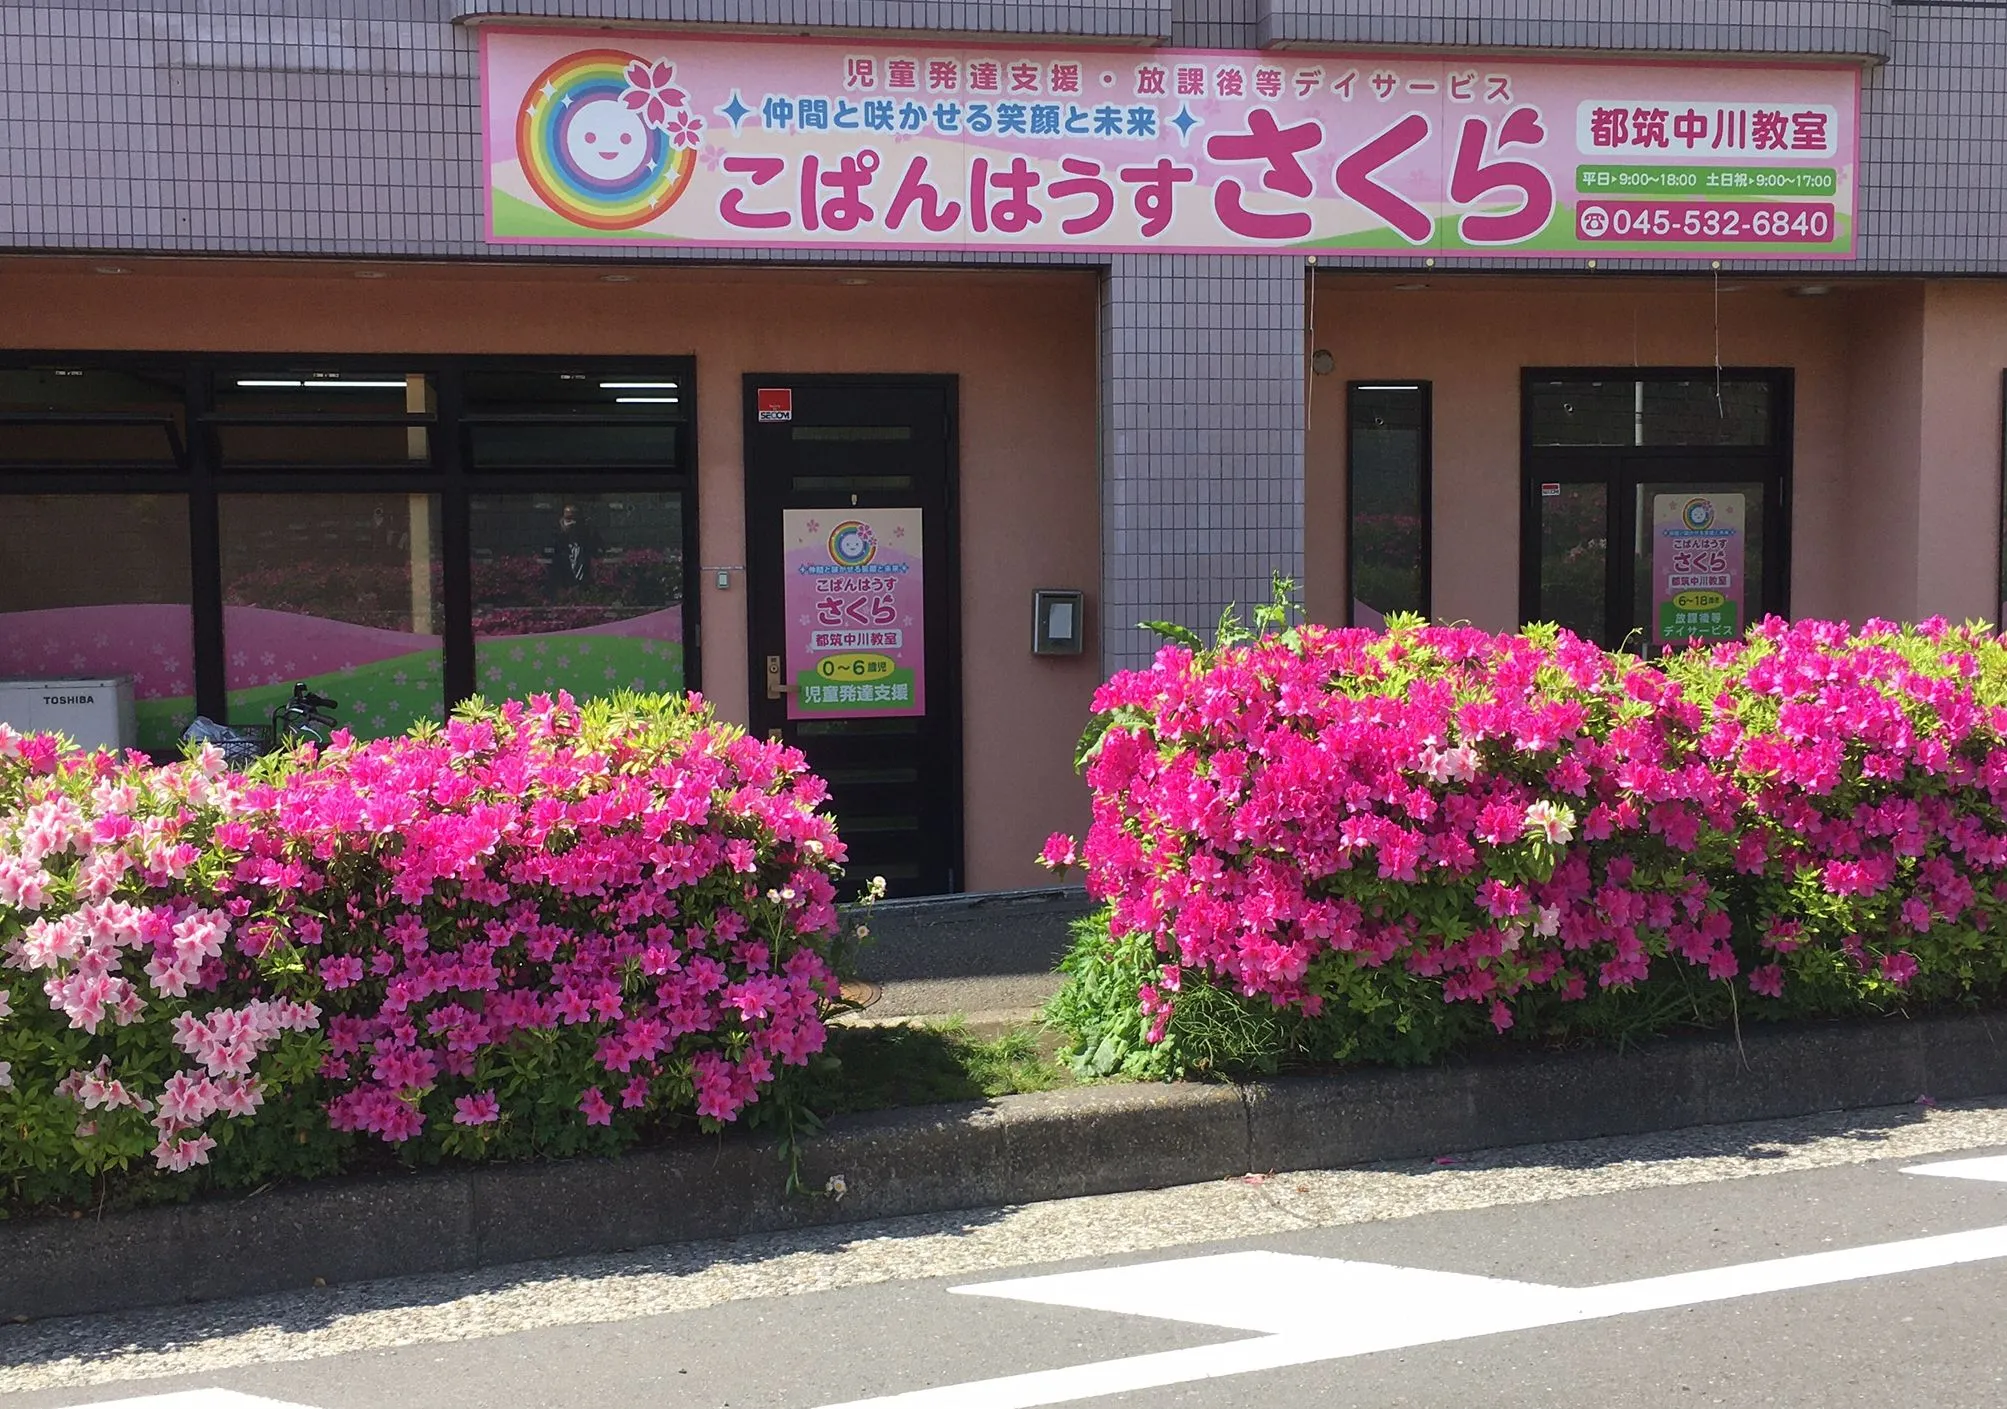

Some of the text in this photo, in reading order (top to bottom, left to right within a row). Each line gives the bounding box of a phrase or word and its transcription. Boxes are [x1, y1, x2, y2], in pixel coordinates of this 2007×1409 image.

[846, 58, 1512, 101] 児童発達支援・放課後等デイサービス
[763, 98, 1156, 137] 仲間と咲かせる笑顔と未来
[1591, 107, 1828, 151] 都筑中川教室
[1612, 209, 1829, 237] 045-532-6840
[760, 411, 790, 420] SECOM
[1674, 552, 1727, 572] さくら
[817, 596, 897, 624] さくら
[816, 632, 897, 647] 都筑中川教室
[1663, 625, 1733, 637] デイサービス
[43, 695, 94, 705] TOSHIBA
